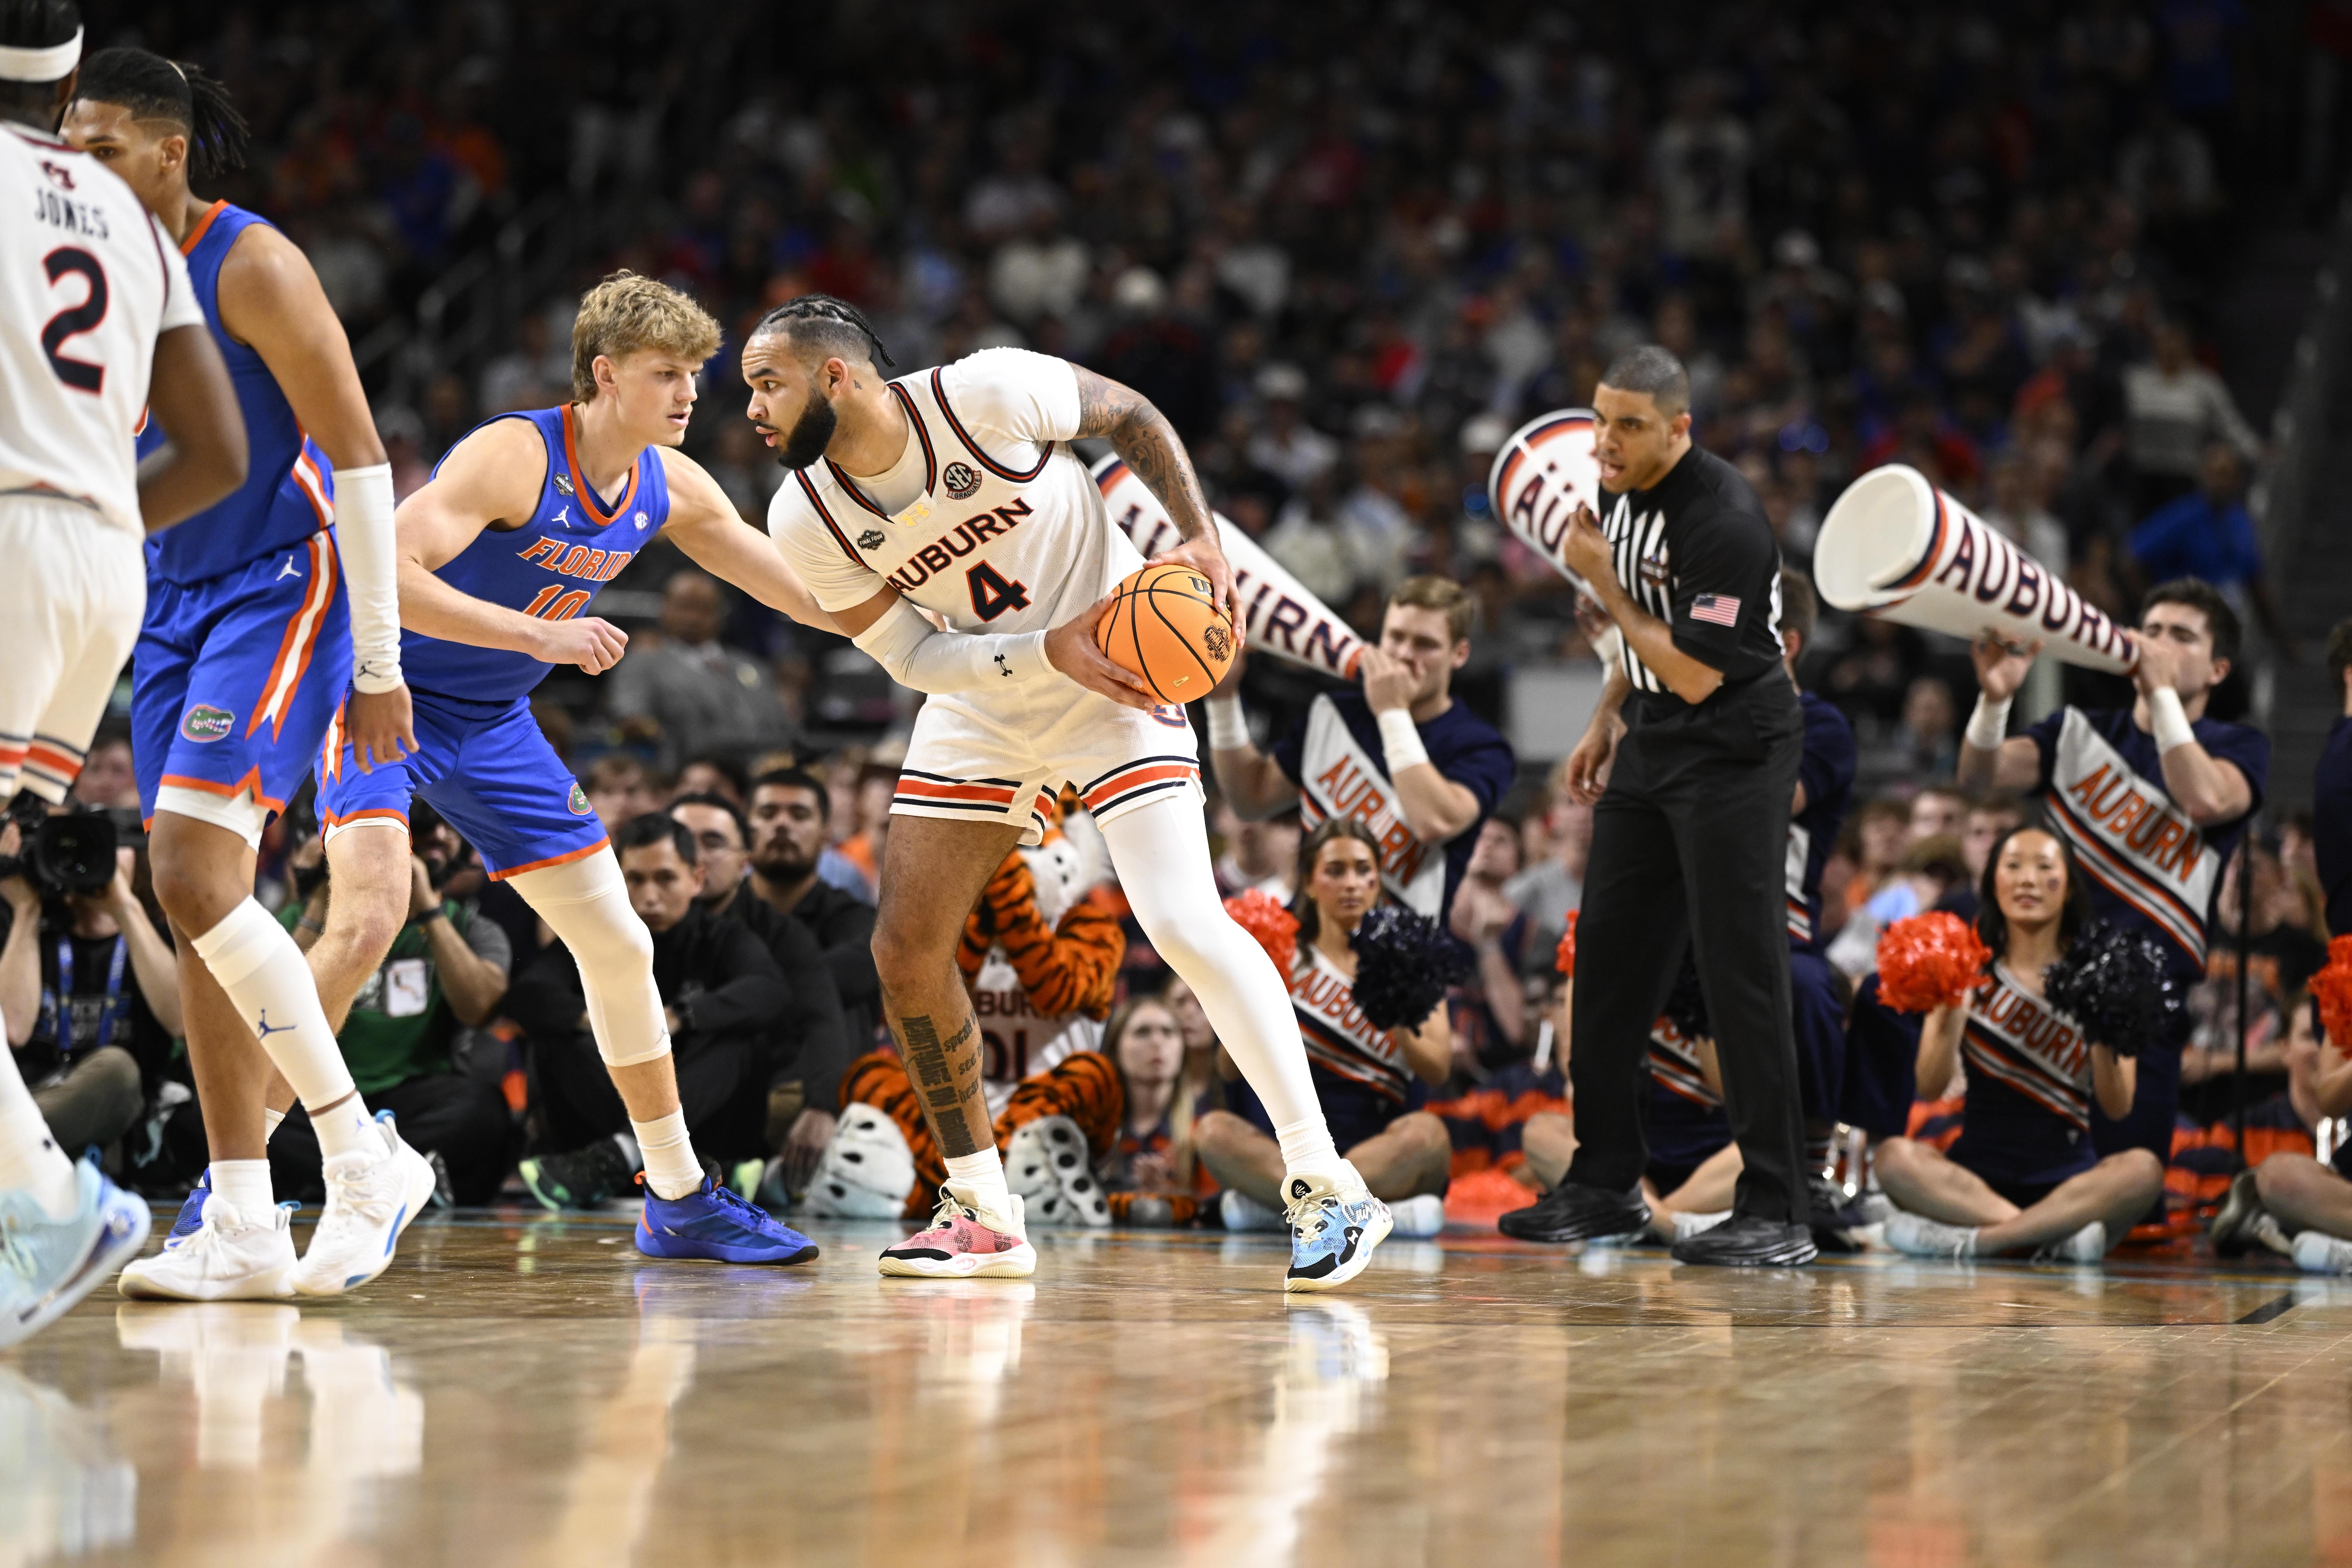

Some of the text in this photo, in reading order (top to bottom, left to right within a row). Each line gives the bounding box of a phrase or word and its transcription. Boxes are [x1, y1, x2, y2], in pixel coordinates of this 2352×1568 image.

[34, 187, 109, 240] JONES
[41, 245, 109, 395] 2
[556, 476, 574, 493] FINAL FOUR
[946, 464, 972, 490] SEC
[954, 478, 981, 499] GRADUATE
[516, 535, 640, 581] FLORID
[871, 533, 883, 542] FOUR
[885, 497, 1034, 594] AUBURN
[965, 559, 1032, 623] 4
[1935, 515, 2135, 662] AUBURN
[2068, 763, 2206, 883] AUBURN
